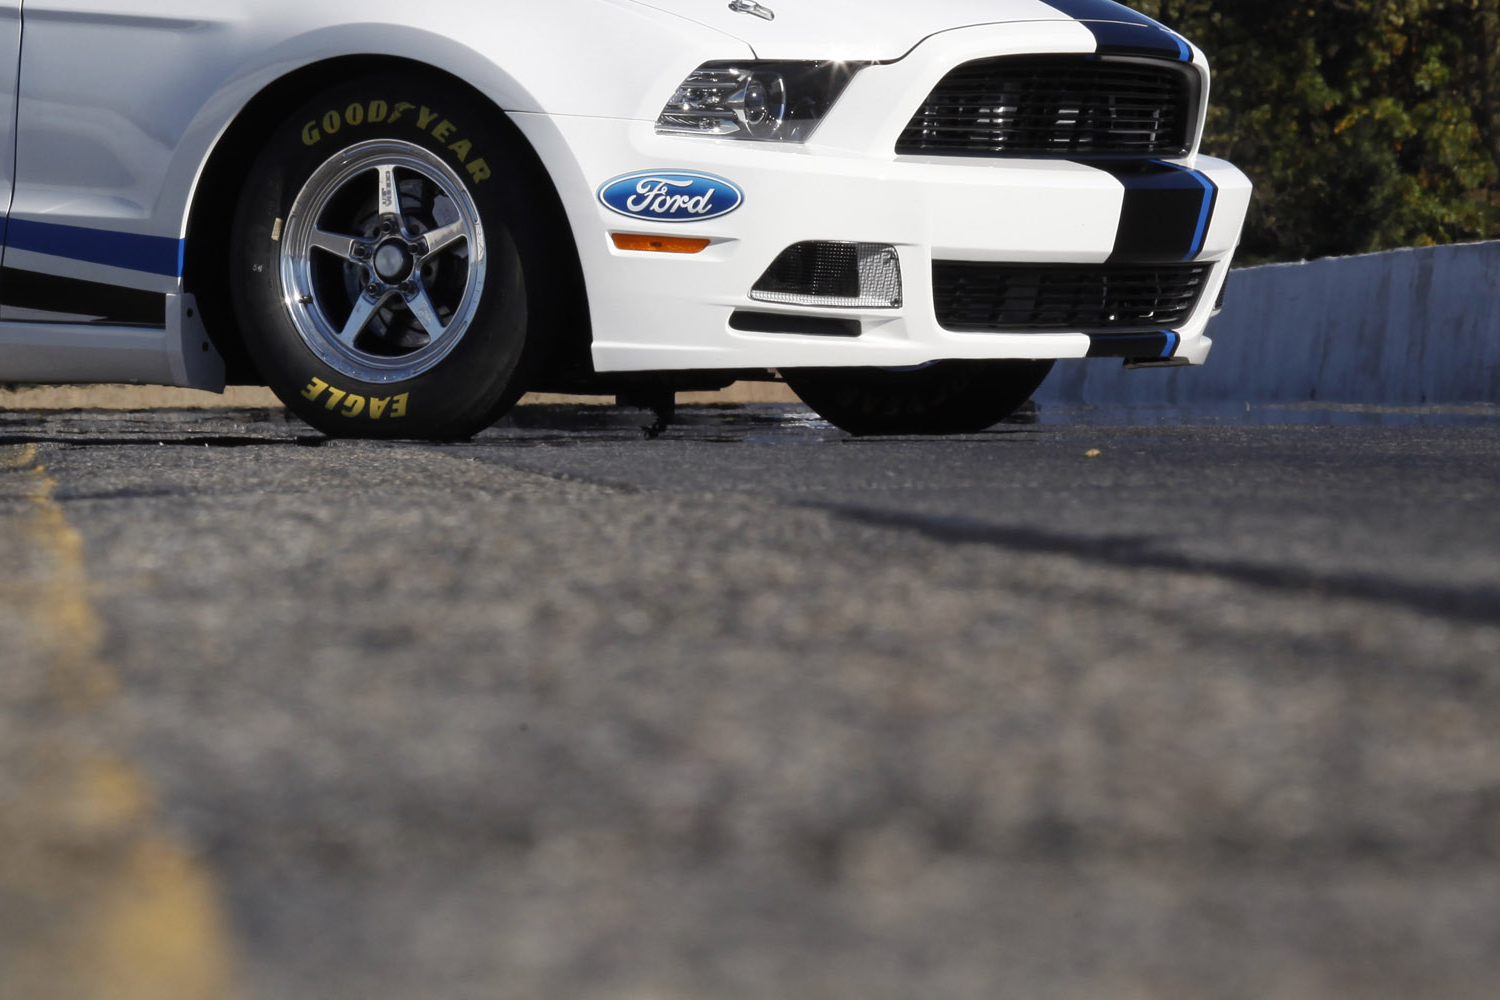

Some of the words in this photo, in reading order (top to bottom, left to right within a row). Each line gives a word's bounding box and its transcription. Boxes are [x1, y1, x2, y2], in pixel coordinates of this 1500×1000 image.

[301, 100, 492, 185] GOODYEAR
[626, 177, 716, 215] Ford
[300, 376, 410, 420] EAGLE
